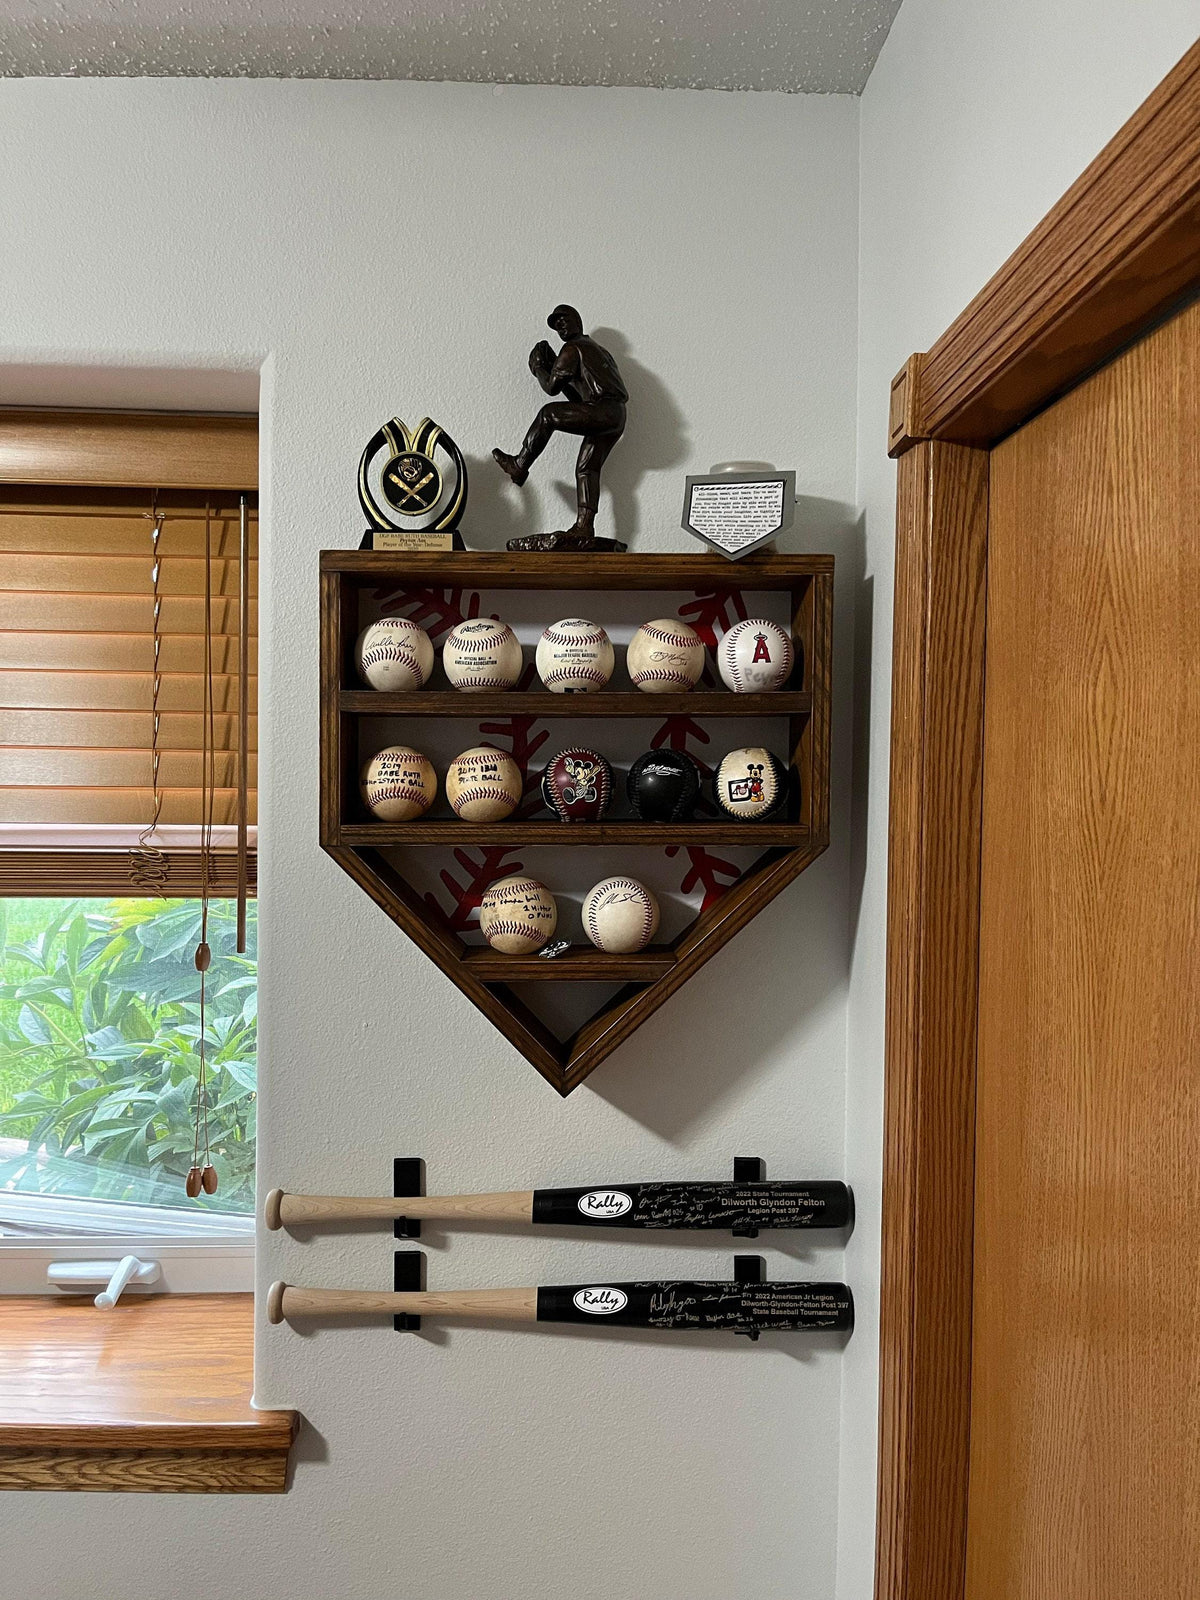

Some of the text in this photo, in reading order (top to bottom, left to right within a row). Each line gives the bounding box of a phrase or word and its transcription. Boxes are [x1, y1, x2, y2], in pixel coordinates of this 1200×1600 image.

[403, 770, 421, 779] RUTH
[408, 779, 425, 788] BALL
[525, 894, 540, 902] ball
[587, 1194, 623, 1213] Rally
[721, 1198, 757, 1206] Dilworth
[759, 1198, 796, 1208] Glyndon
[798, 1198, 826, 1206] Felton
[583, 1291, 619, 1309] Rally
[741, 1300, 820, 1309] Dilworth-Glyndon-Felton
